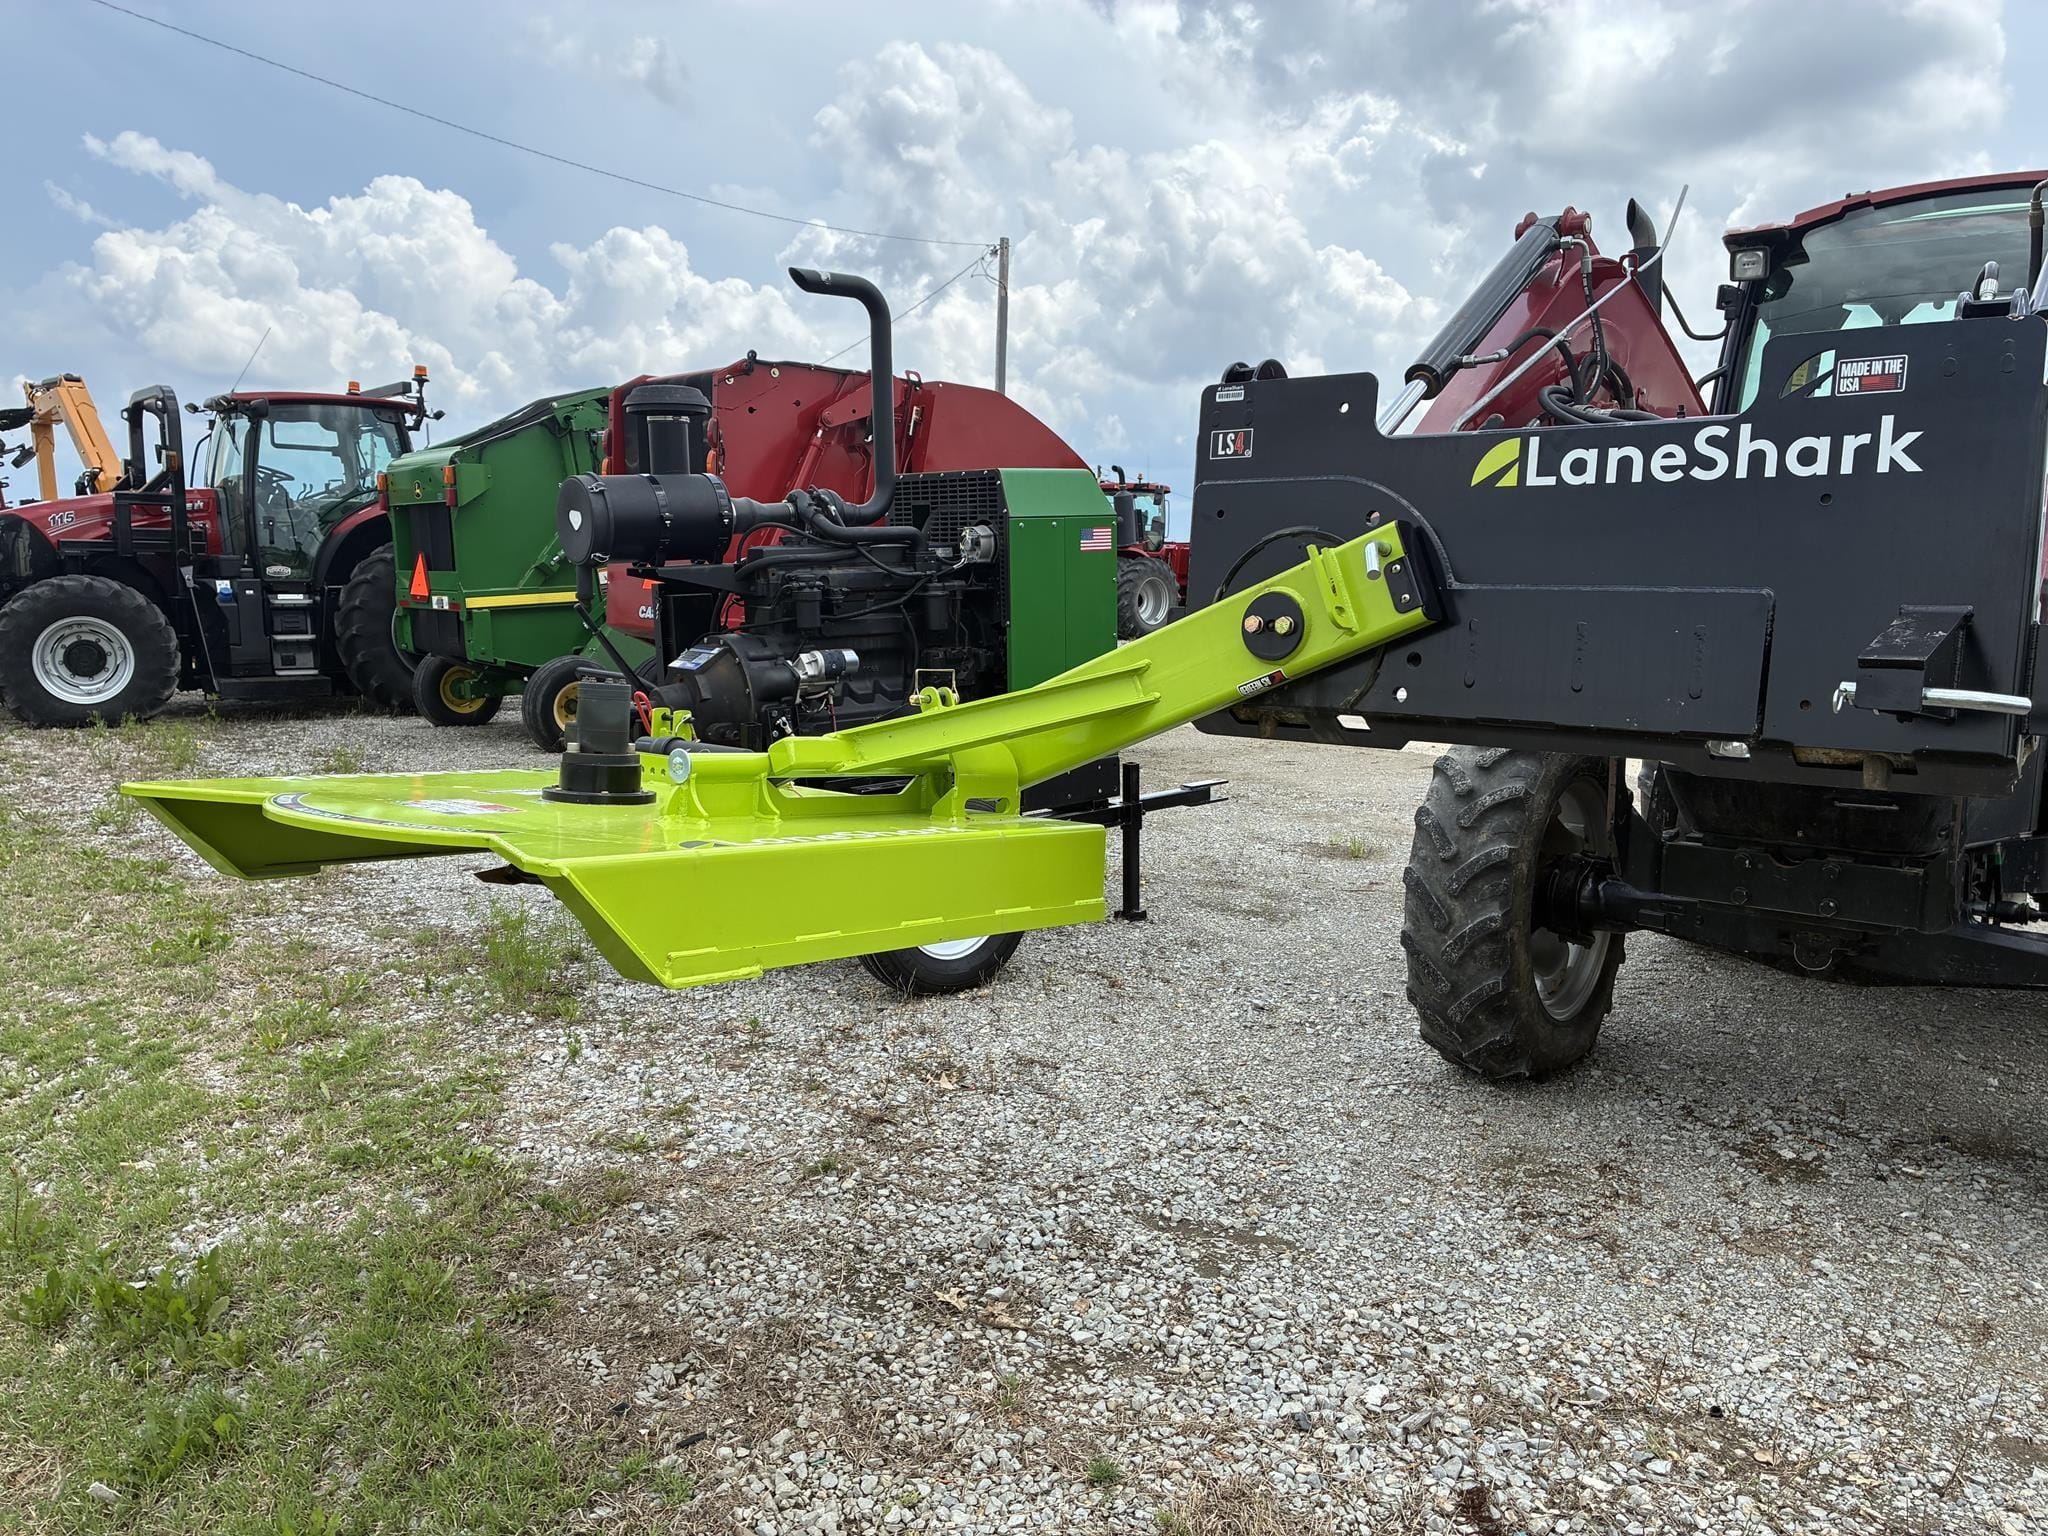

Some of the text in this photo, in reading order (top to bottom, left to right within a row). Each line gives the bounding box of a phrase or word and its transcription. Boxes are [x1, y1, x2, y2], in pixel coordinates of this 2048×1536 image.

[1841, 359, 1904, 377] MADE IN THE
[1840, 377, 1860, 393] USA
[1218, 432, 1244, 455] LS4
[1525, 415, 1925, 487] LaneShark
[48, 510, 76, 527] 115
